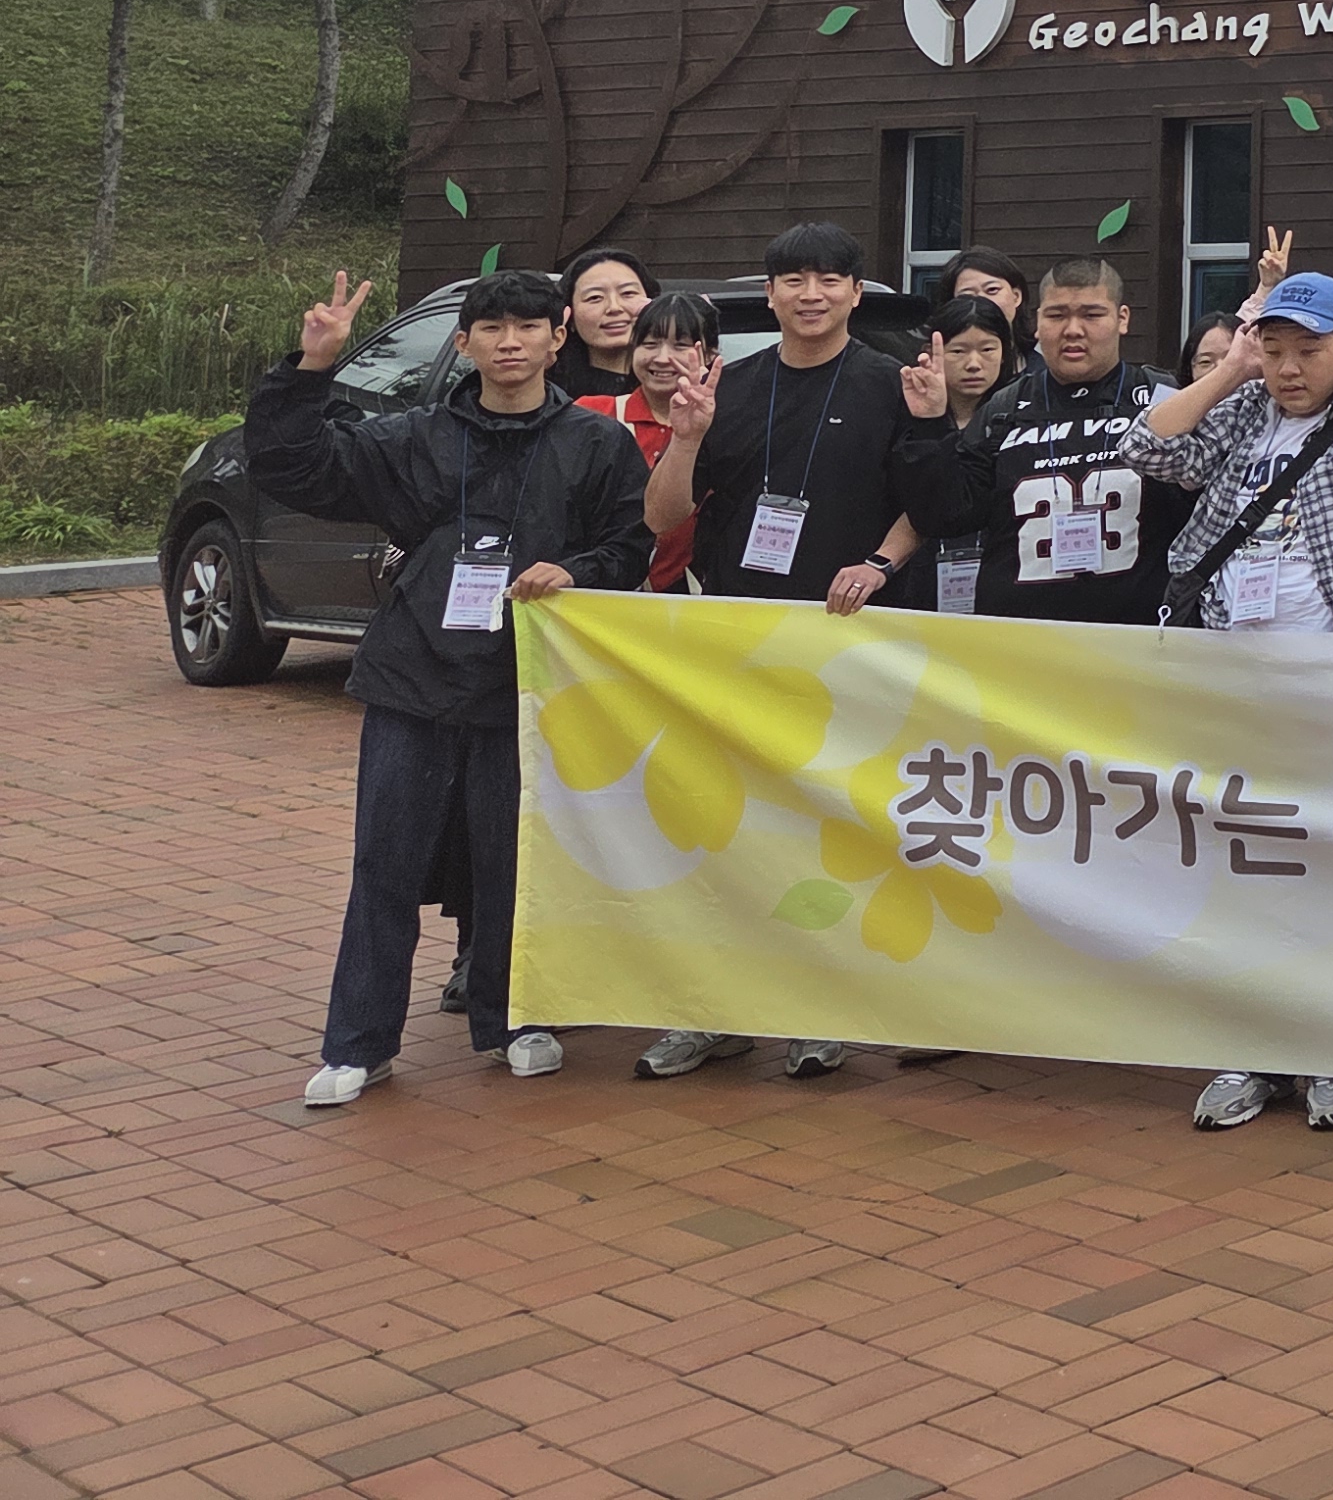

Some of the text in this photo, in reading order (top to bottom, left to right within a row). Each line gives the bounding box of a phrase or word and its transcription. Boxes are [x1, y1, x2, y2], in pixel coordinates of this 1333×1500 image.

[1028, 10, 1270, 58] Geochang
[1033, 454, 1084, 470] WORK
[1013, 468, 1144, 585] 23
[897, 746, 1312, 881] 찾아가는
